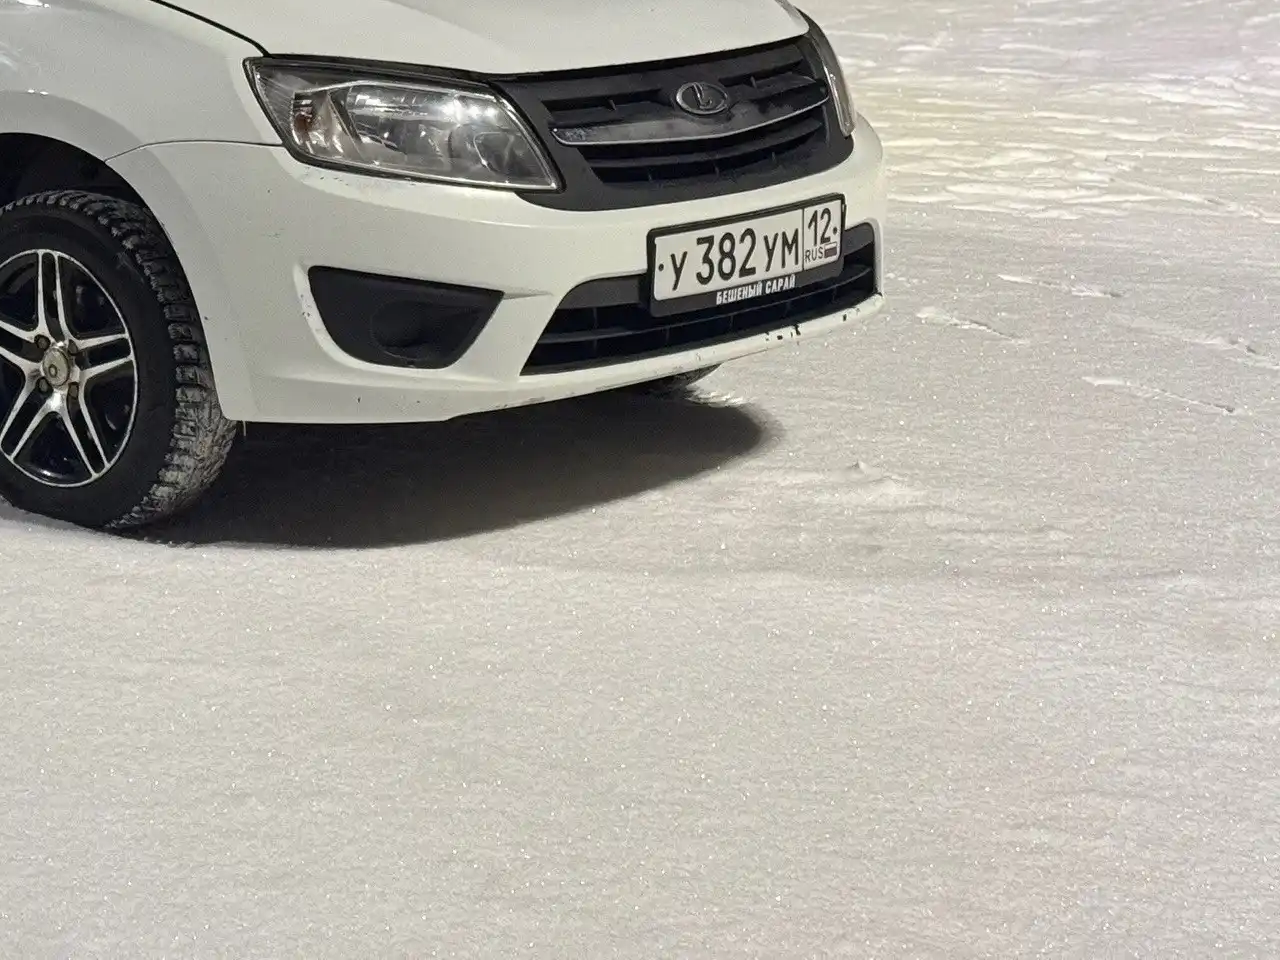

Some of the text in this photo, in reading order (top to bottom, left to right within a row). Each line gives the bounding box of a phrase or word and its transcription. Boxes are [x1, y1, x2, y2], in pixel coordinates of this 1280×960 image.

[808, 208, 831, 246] 12
[805, 246, 824, 263] RUS
[716, 274, 796, 305] БЕШЕНЫЙ САРАЙ
